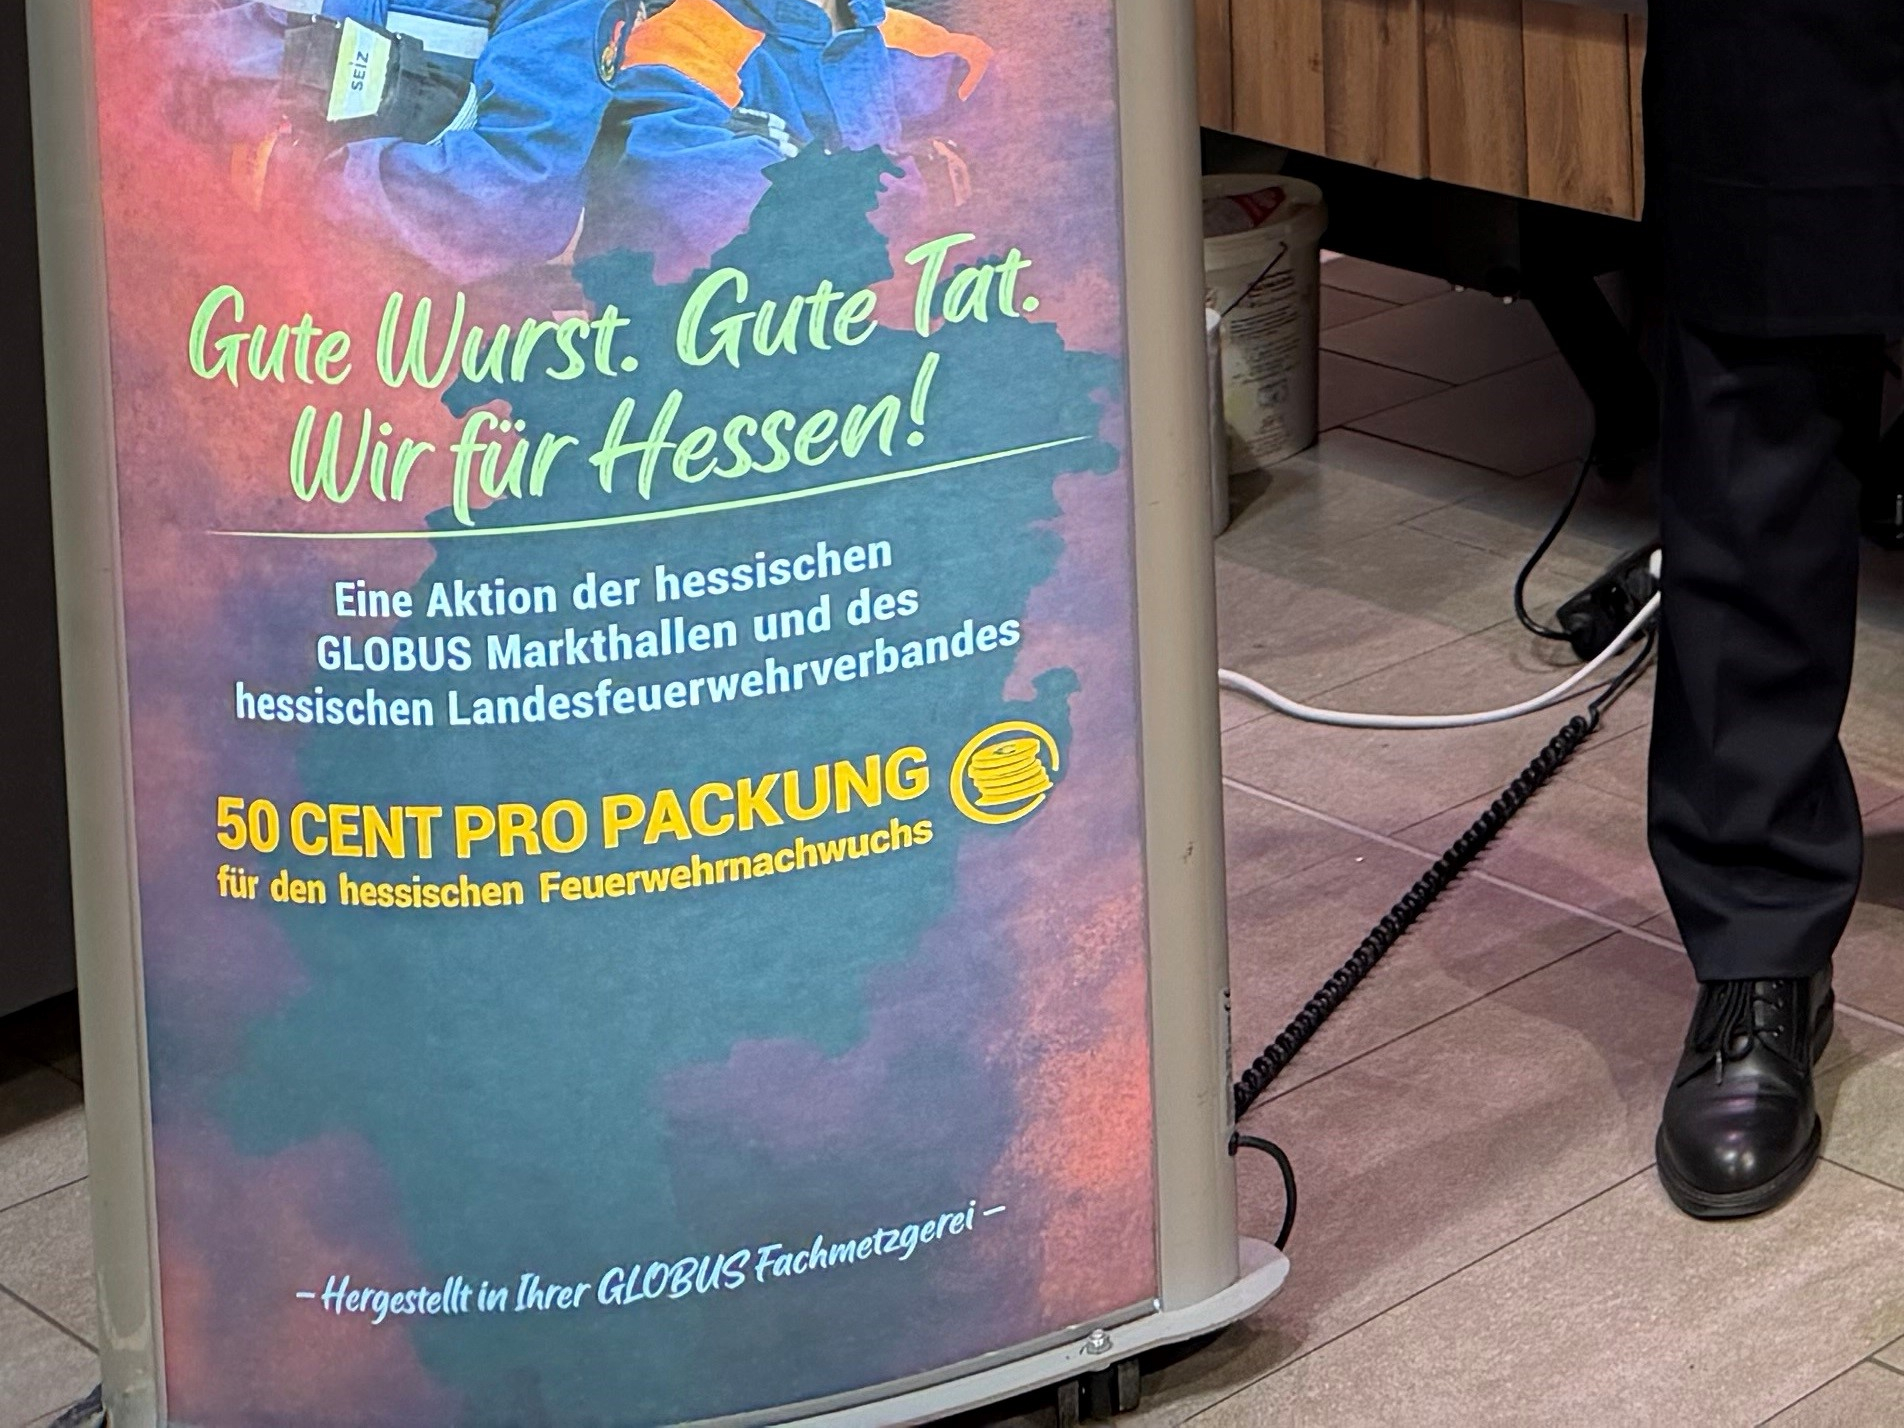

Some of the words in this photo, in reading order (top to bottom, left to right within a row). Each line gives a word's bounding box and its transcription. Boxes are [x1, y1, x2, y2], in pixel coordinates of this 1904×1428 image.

[189, 284, 351, 387] Gute
[377, 292, 638, 389] Wurst.
[677, 268, 876, 367] Gute
[903, 232, 1040, 337] Tat.
[289, 405, 435, 505] Wir
[449, 411, 581, 528] für
[589, 353, 940, 500] Hessen!
[316, 633, 472, 673] GLOBUS
[487, 615, 737, 671] Markthallen
[753, 599, 832, 644] und
[847, 585, 920, 627] des
[335, 580, 412, 619] Eine
[427, 578, 559, 619] Aktion
[573, 570, 641, 610] der
[654, 537, 892, 605] hessischen
[234, 682, 433, 727] hessischen
[449, 615, 1021, 726] Landesfeuerwehrverbandes
[216, 796, 279, 853] 50
[291, 803, 442, 860] CENT
[455, 797, 588, 859] PRO
[603, 744, 930, 849] PACKUNG
[217, 864, 259, 900] für
[270, 869, 327, 906] den
[340, 871, 524, 908] hessischen
[539, 816, 934, 904] Feuerwehrnachwuchs
[321, 1277, 473, 1326] Hergestellt
[478, 1283, 509, 1314] in
[512, 1273, 591, 1314] Ihrer
[597, 1248, 752, 1308] GLOBUS
[755, 1199, 976, 1285] Fachmetzgerei
